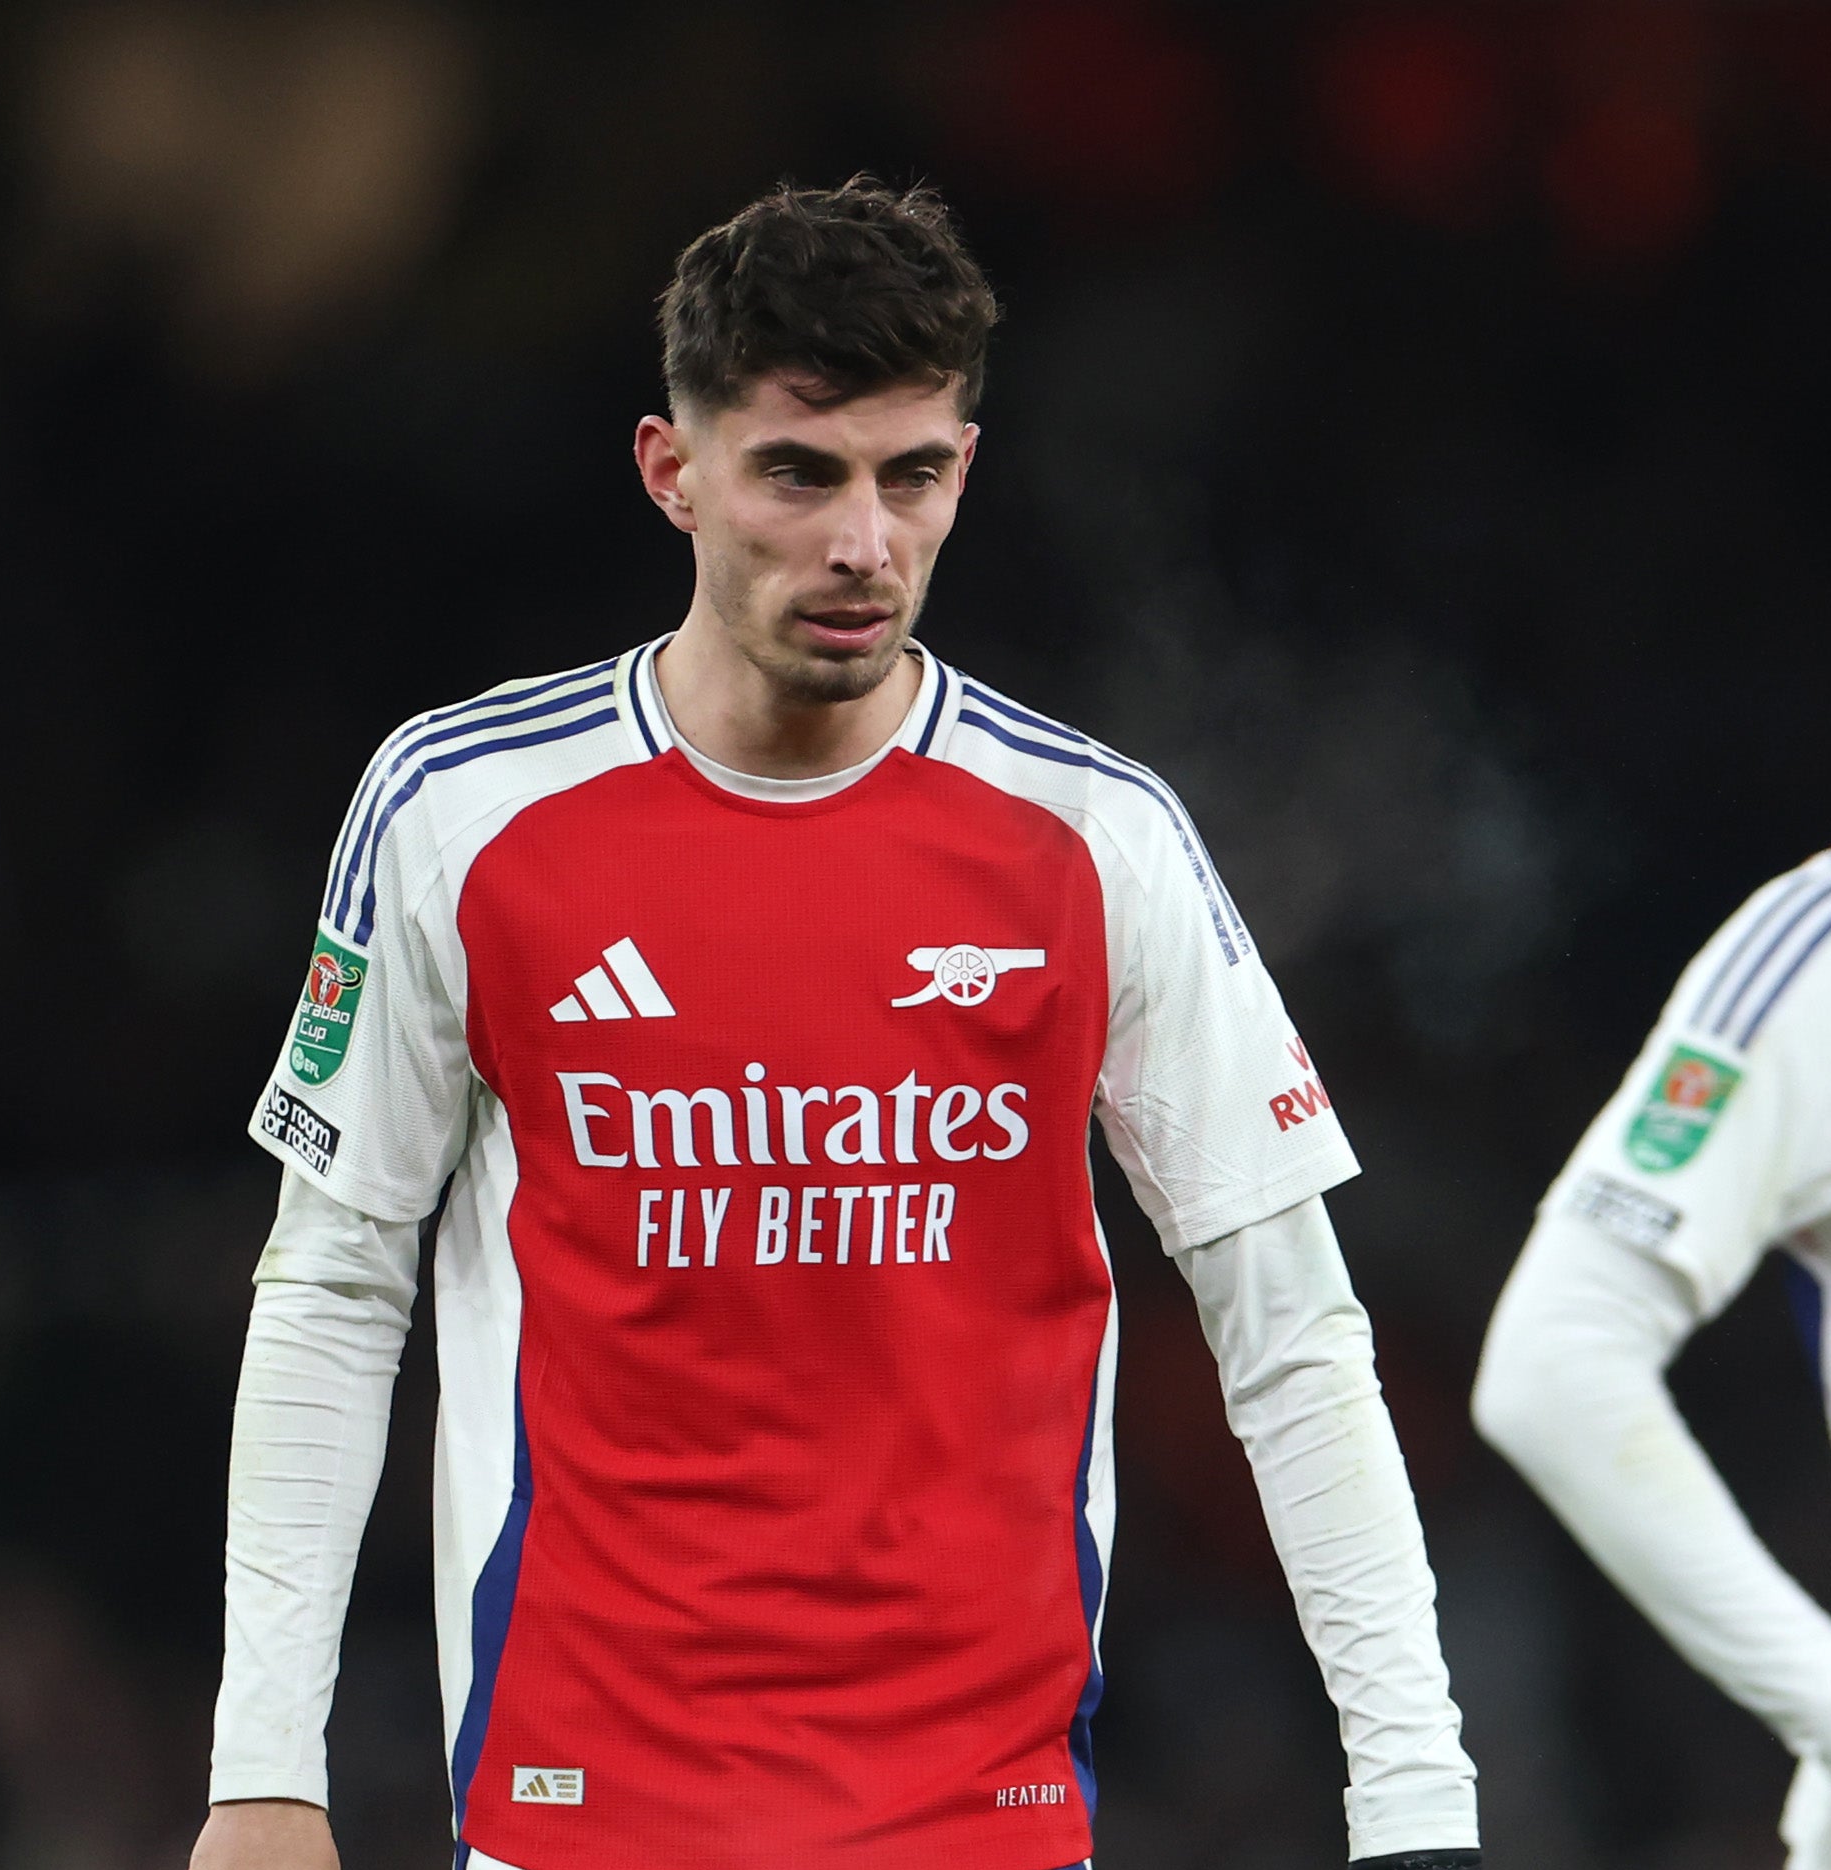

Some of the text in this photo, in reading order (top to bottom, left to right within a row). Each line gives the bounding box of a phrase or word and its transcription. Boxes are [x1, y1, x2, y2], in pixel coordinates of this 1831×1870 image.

[299, 1018, 328, 1042] Cup
[300, 1000, 351, 1025] arabao
[303, 1056, 320, 1080] EFL
[290, 1101, 331, 1150] room
[555, 1062, 1030, 1168] Emirates
[285, 1123, 332, 1177] racism
[637, 1183, 955, 1268] FLY BETTER
[996, 1784, 1066, 1808] HEAT.RDY
